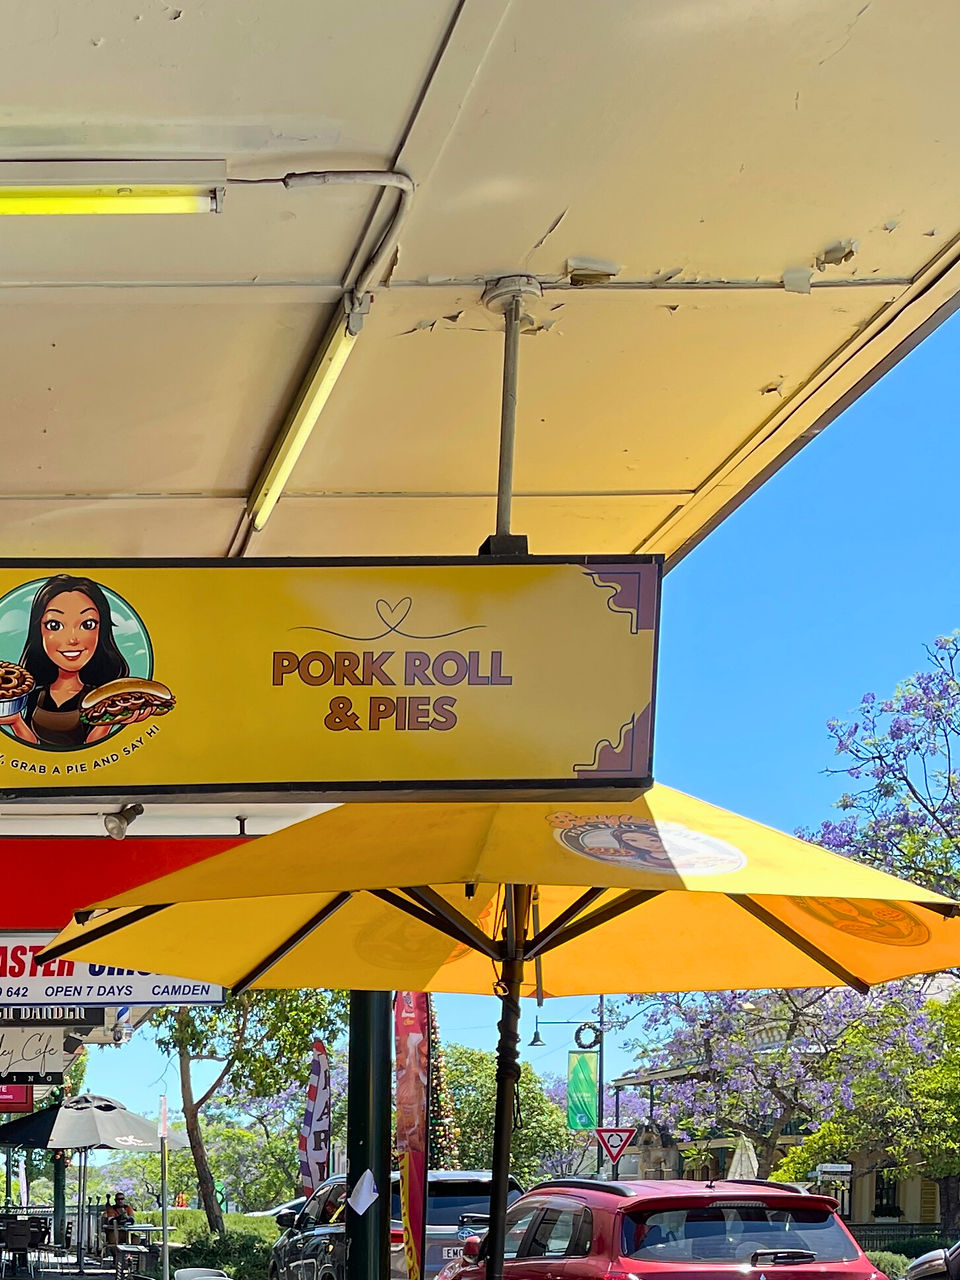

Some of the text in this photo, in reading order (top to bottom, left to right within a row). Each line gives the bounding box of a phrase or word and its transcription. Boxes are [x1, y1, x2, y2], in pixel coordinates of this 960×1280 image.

[272, 650, 513, 686] PORK ROLL
[324, 695, 458, 731] & PIES
[10, 759, 47, 774] GRAB
[52, 766, 61, 775] A
[66, 763, 88, 774] PIE
[93, 753, 120, 770] AND
[122, 737, 145, 756] SAY
[147, 724, 161, 738] HI
[6, 986, 29, 998] 642
[44, 985, 76, 997] OPEN
[86, 985, 94, 997] 7
[96, 985, 133, 997] DAYS
[151, 984, 210, 996] CAMDEN
[21, 1033, 59, 1077] Cafe
